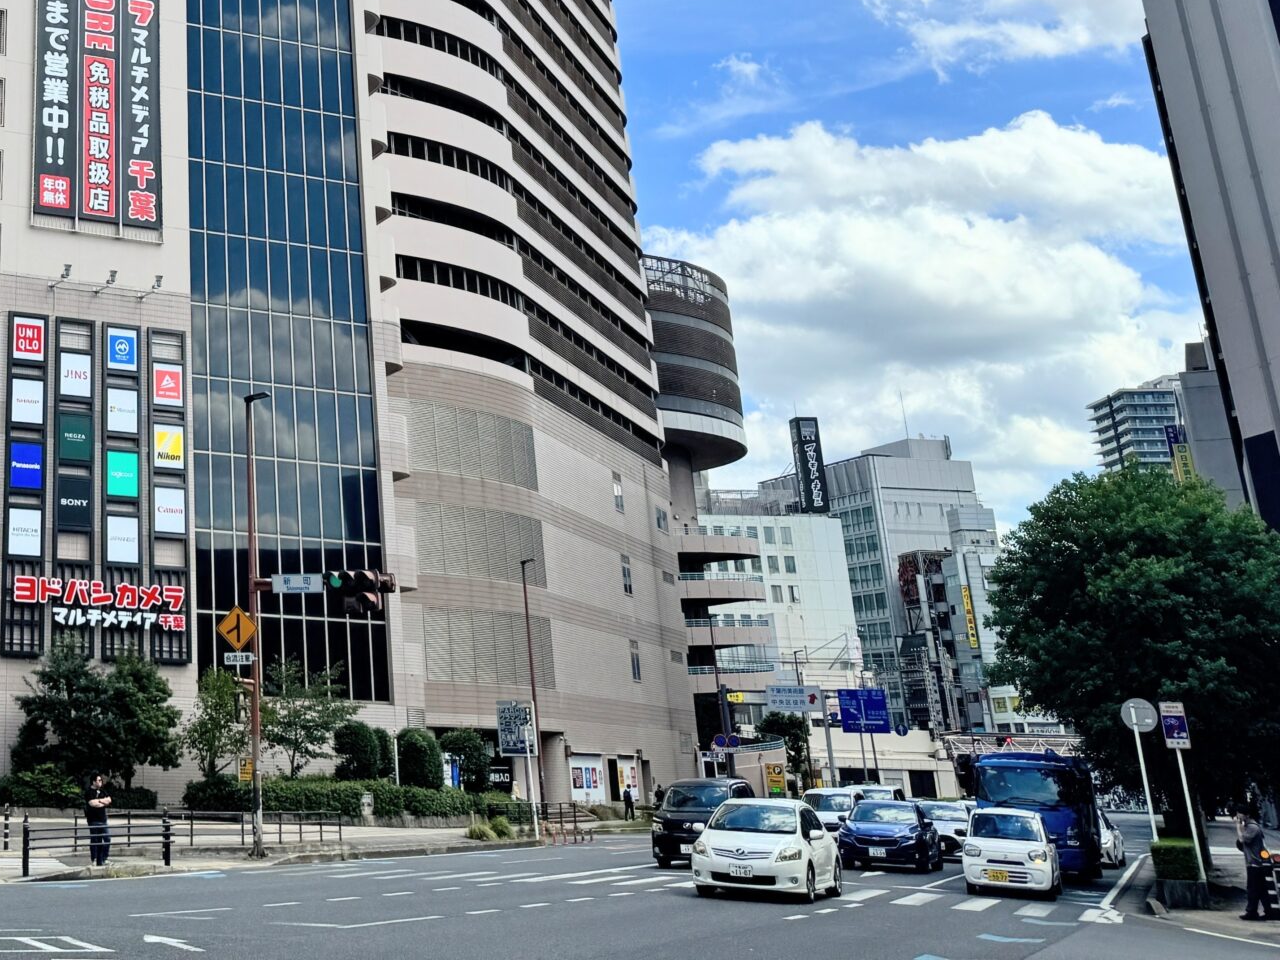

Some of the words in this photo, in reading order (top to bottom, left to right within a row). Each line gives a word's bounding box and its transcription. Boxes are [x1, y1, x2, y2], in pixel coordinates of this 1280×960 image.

[88, 61, 110, 212] 免税品取扱店
[18, 327, 38, 338] UNI
[18, 340, 39, 351] QLO
[157, 451, 181, 461] Nikon
[11, 461, 41, 470] Panasonic
[60, 498, 88, 507] SONY
[157, 506, 183, 515] Canon
[14, 575, 185, 611] ヨドバシカメラ
[53, 607, 186, 632] マルチメディア千葉
